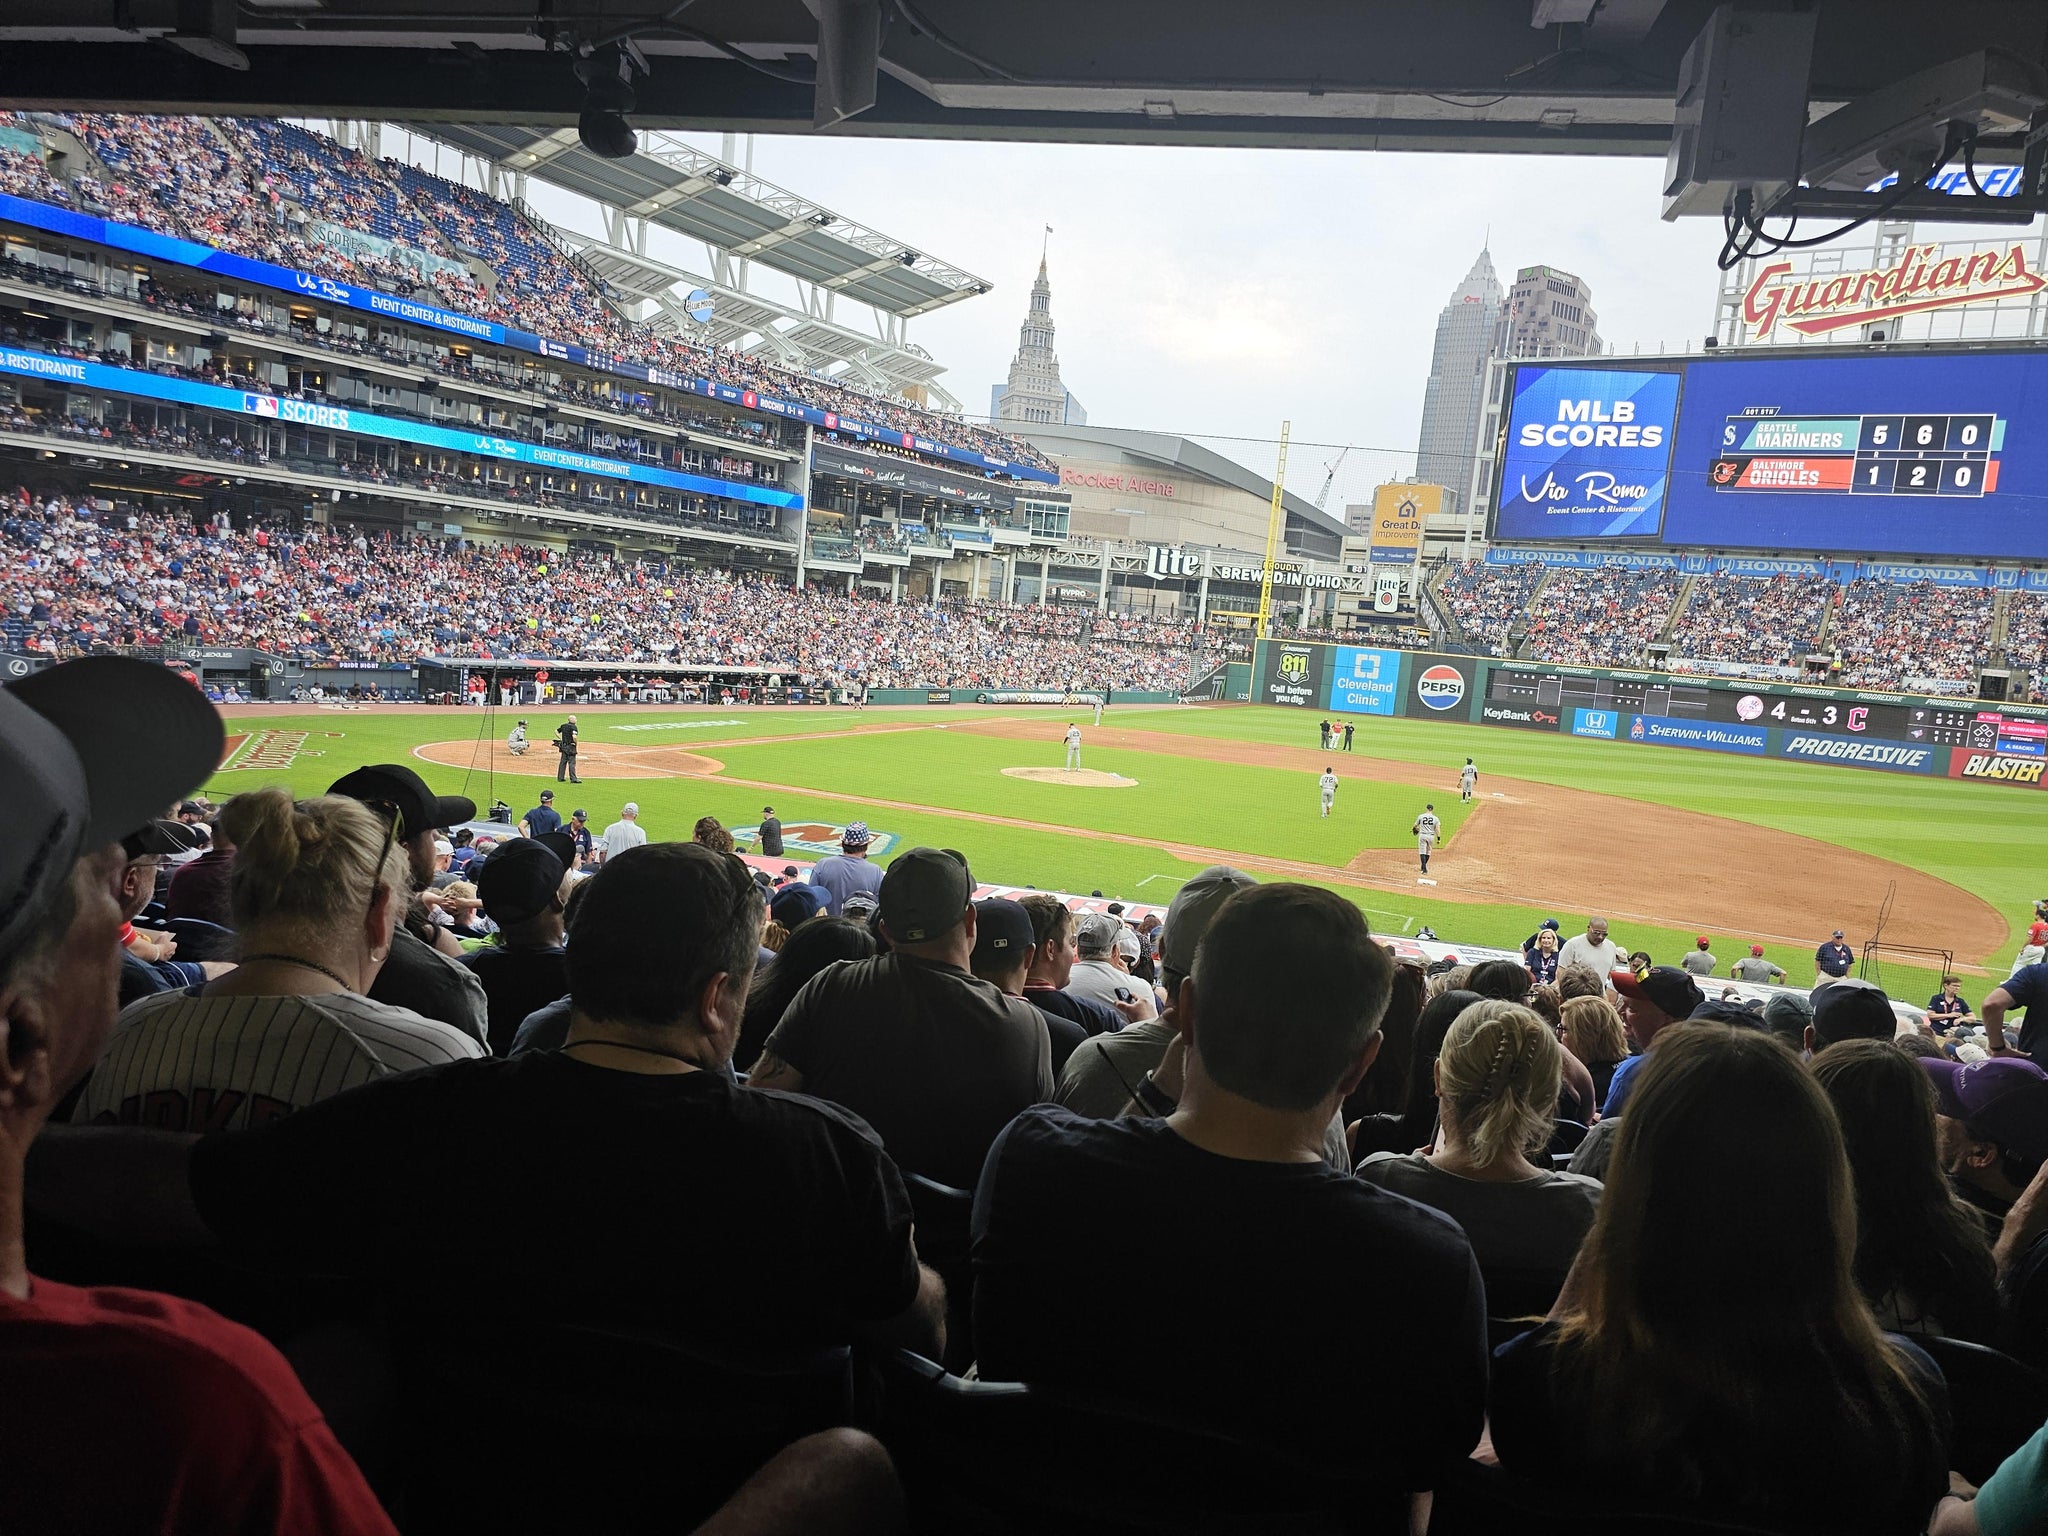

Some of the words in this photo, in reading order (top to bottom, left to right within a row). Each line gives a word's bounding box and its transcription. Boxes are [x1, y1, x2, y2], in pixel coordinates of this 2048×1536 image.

[1743, 243, 2030, 343] Guardians
[371, 295, 401, 314] EVENT
[401, 303, 434, 322] CENTER
[434, 311, 443, 325] &
[443, 313, 492, 338] RISTORANTE
[9, 354, 86, 380] RISTORANTE
[282, 400, 349, 429] SCORES
[760, 398, 785, 412] ROCCHIO
[787, 405, 796, 415] 0-1
[1557, 399, 1636, 423] MLB
[827, 415, 836, 425] 37
[840, 420, 862, 433] BAZZANA
[864, 427, 873, 436] 0-2
[1519, 424, 1664, 448] SCORES
[1755, 432, 1843, 448] MARINERS
[1757, 423, 1798, 432] SEATTLE
[1872, 425, 1888, 445] 5
[1916, 425, 1933, 445] 6
[1961, 425, 1978, 445] 0
[533, 450, 558, 464] EVENT
[557, 453, 584, 468] CENTER
[591, 459, 630, 477] RISTORANTE
[1873, 451, 1879, 459] R
[1918, 451, 1924, 459] H
[844, 463, 864, 475] KeyBank
[1752, 461, 1804, 470] BALTIMORE
[1868, 466, 1880, 485] 1
[1910, 466, 1927, 486] 2
[1955, 467, 1972, 487] 0
[1062, 468, 1123, 491] Rocket
[1126, 475, 1175, 497] Arena
[1749, 470, 1820, 486] ORIOLES
[1521, 471, 1569, 503] Via
[1575, 471, 1648, 504] Roma
[1547, 506, 1570, 514] Event
[1571, 506, 1598, 514] Center
[1606, 505, 1646, 513] Ristorante
[1382, 520, 1409, 530] Great
[1144, 546, 1200, 581] Lite
[1511, 551, 1580, 563] HONDA
[1601, 554, 1676, 567] HONDA
[1735, 560, 1818, 574] HONDA
[1888, 568, 1978, 582] HONDA
[1286, 572, 1302, 586] IN
[1305, 574, 1341, 589] OHIO
[1380, 579, 1398, 591] Lite
[1051, 587, 1086, 598] SRVPRO
[1282, 654, 1308, 673] 811
[1270, 683, 1285, 694] Call
[1286, 685, 1313, 696] before
[1337, 678, 1393, 693] Cleveland
[1421, 682, 1462, 694] PEPSI
[1501, 662, 1540, 671] PROGRESSIVE
[1554, 666, 1595, 675] PROGRESSIVE
[1609, 671, 1652, 681] PROGRESSIVE
[1667, 676, 1710, 686] PROGRESSIVE
[1728, 681, 1771, 692] PROGRESSIVE
[1790, 687, 1837, 697] PROGRESSIVE
[1856, 692, 1904, 702] PROGRESSIVE
[1925, 698, 1976, 709] PROGRESSIVE
[1996, 704, 2048, 715] PROGRESSIVE
[1237, 692, 1249, 700] 325
[1275, 694, 1291, 705] you
[1291, 694, 1306, 705] dig.
[1347, 693, 1380, 706] Clinic
[1483, 707, 1531, 722] KeyBank
[1770, 701, 1786, 720] 4
[1822, 705, 1838, 725] 3
[1847, 706, 1869, 732] C
[1576, 726, 1612, 737] HONDA
[1648, 724, 1764, 747] SHERWIN-WILLIAMS.
[1787, 736, 1927, 767] PROGRESSIVE
[1963, 755, 2046, 783] BLASTER
[1324, 776, 1334, 784] 72
[1422, 817, 1434, 826] 22
